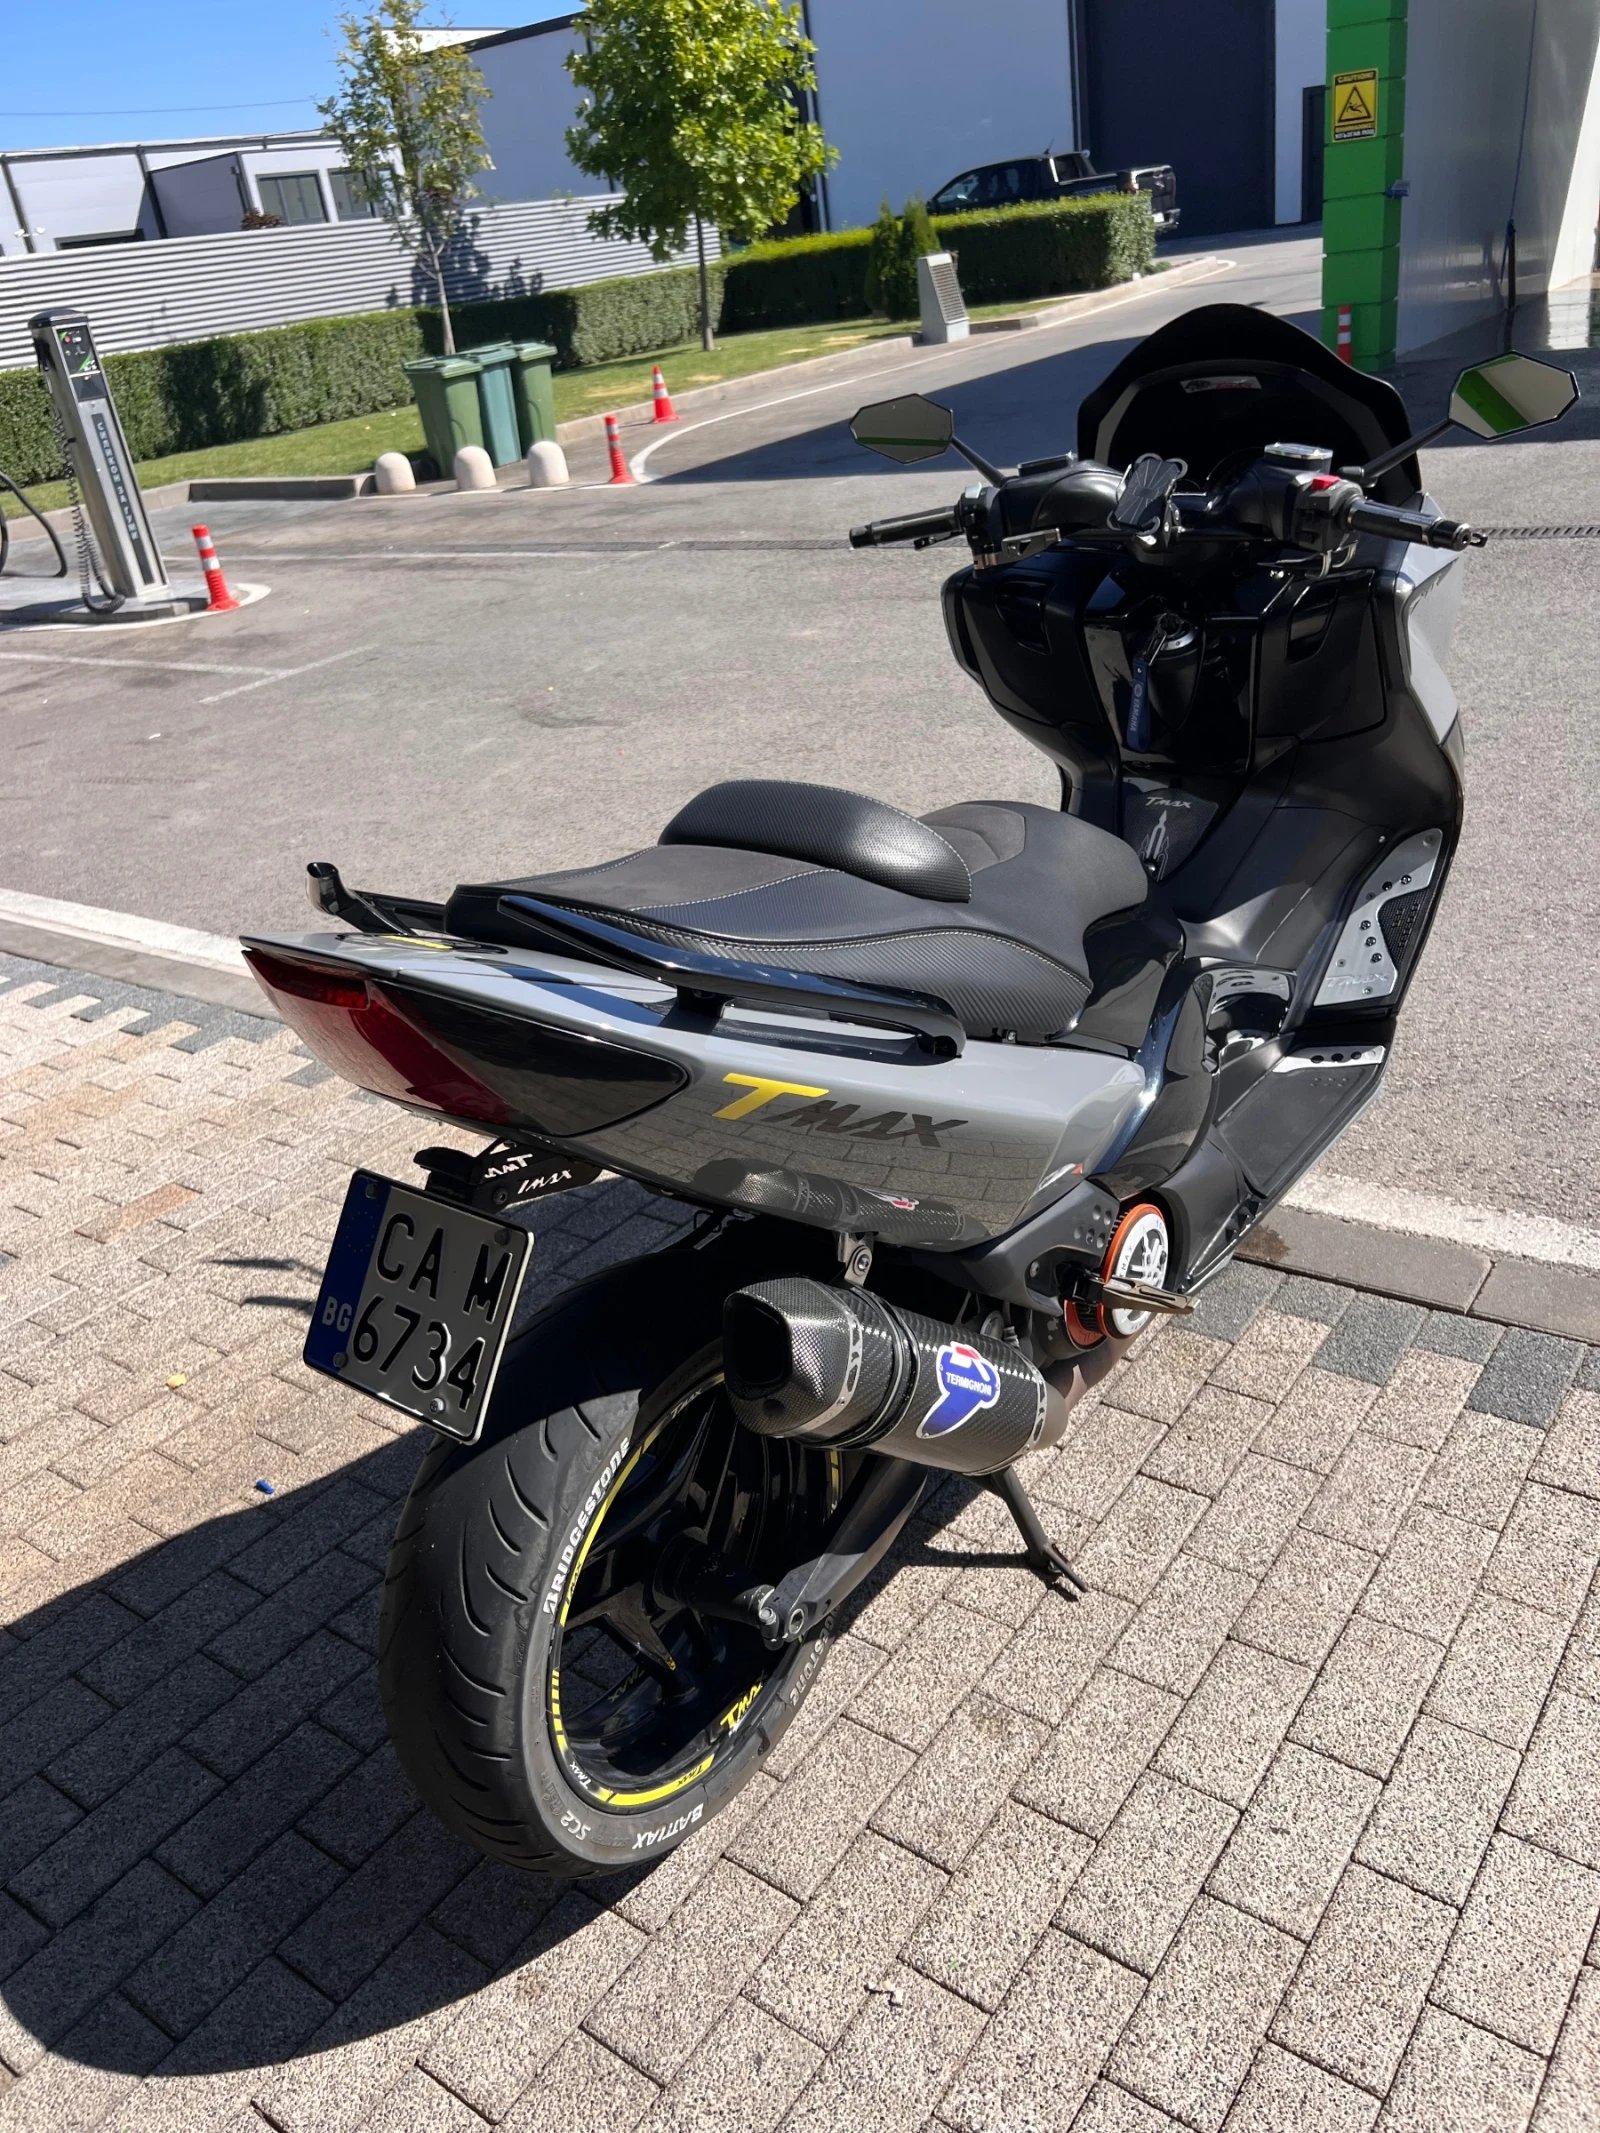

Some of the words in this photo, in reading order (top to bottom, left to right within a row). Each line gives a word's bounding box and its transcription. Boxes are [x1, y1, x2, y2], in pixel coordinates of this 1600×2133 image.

[1129, 697, 1146, 732] YAMAHA
[376, 1212, 445, 1301] CA
[461, 1242, 514, 1325] M
[321, 1295, 353, 1334] BG
[352, 1294, 487, 1413] 6734
[945, 1371, 993, 1397] TERMIGNONI
[542, 1436, 632, 1617] BRIDGESTONE
[560, 1809, 592, 1841] SC2
